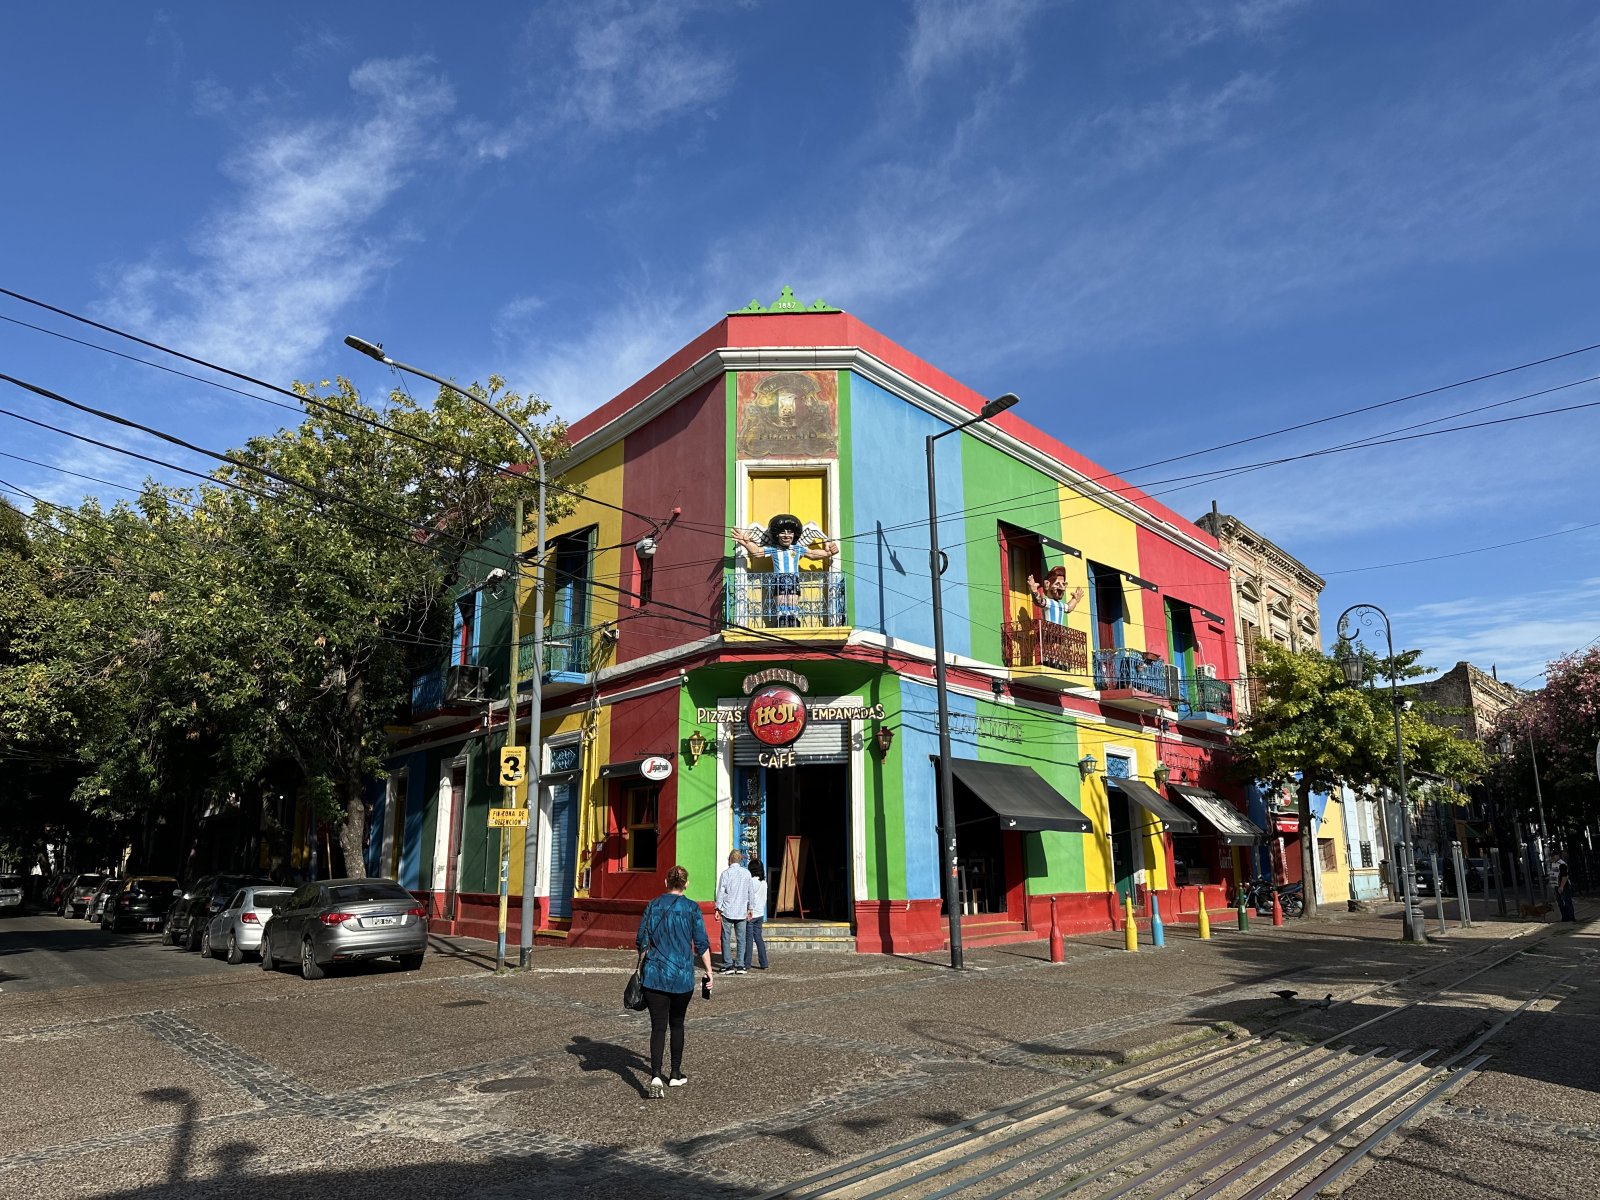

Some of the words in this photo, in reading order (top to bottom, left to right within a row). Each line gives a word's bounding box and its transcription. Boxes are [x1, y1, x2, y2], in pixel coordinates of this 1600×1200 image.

[697, 708, 742, 724] PIZZAS
[755, 703, 798, 726] HUT
[812, 703, 886, 721] EMPANADAS
[503, 756, 520, 782] 3
